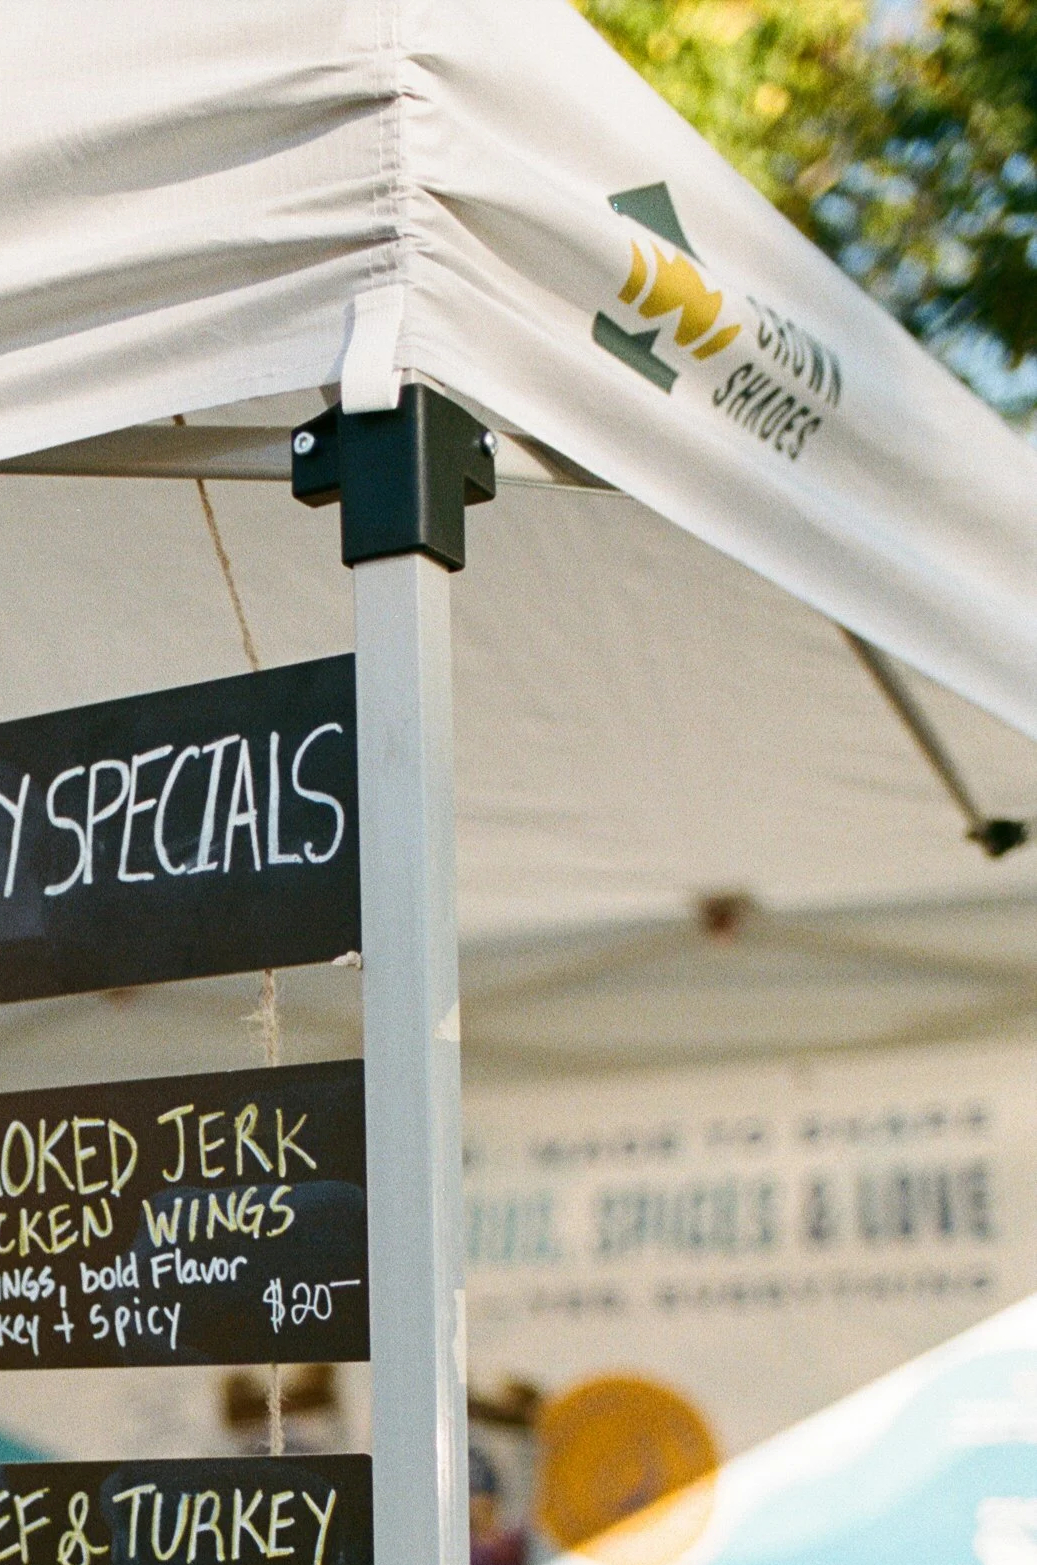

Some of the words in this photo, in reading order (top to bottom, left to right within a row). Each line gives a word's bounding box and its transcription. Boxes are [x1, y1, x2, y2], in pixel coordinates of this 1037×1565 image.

[712, 362, 823, 462] SHADES
[44, 723, 345, 896] SPECIALS
[158, 1103, 317, 1184] JERK
[143, 1186, 296, 1249] WINGS
[80, 1251, 139, 1293] bold
[150, 1248, 247, 1289] Flavor
[54, 1310, 74, 1344] +
